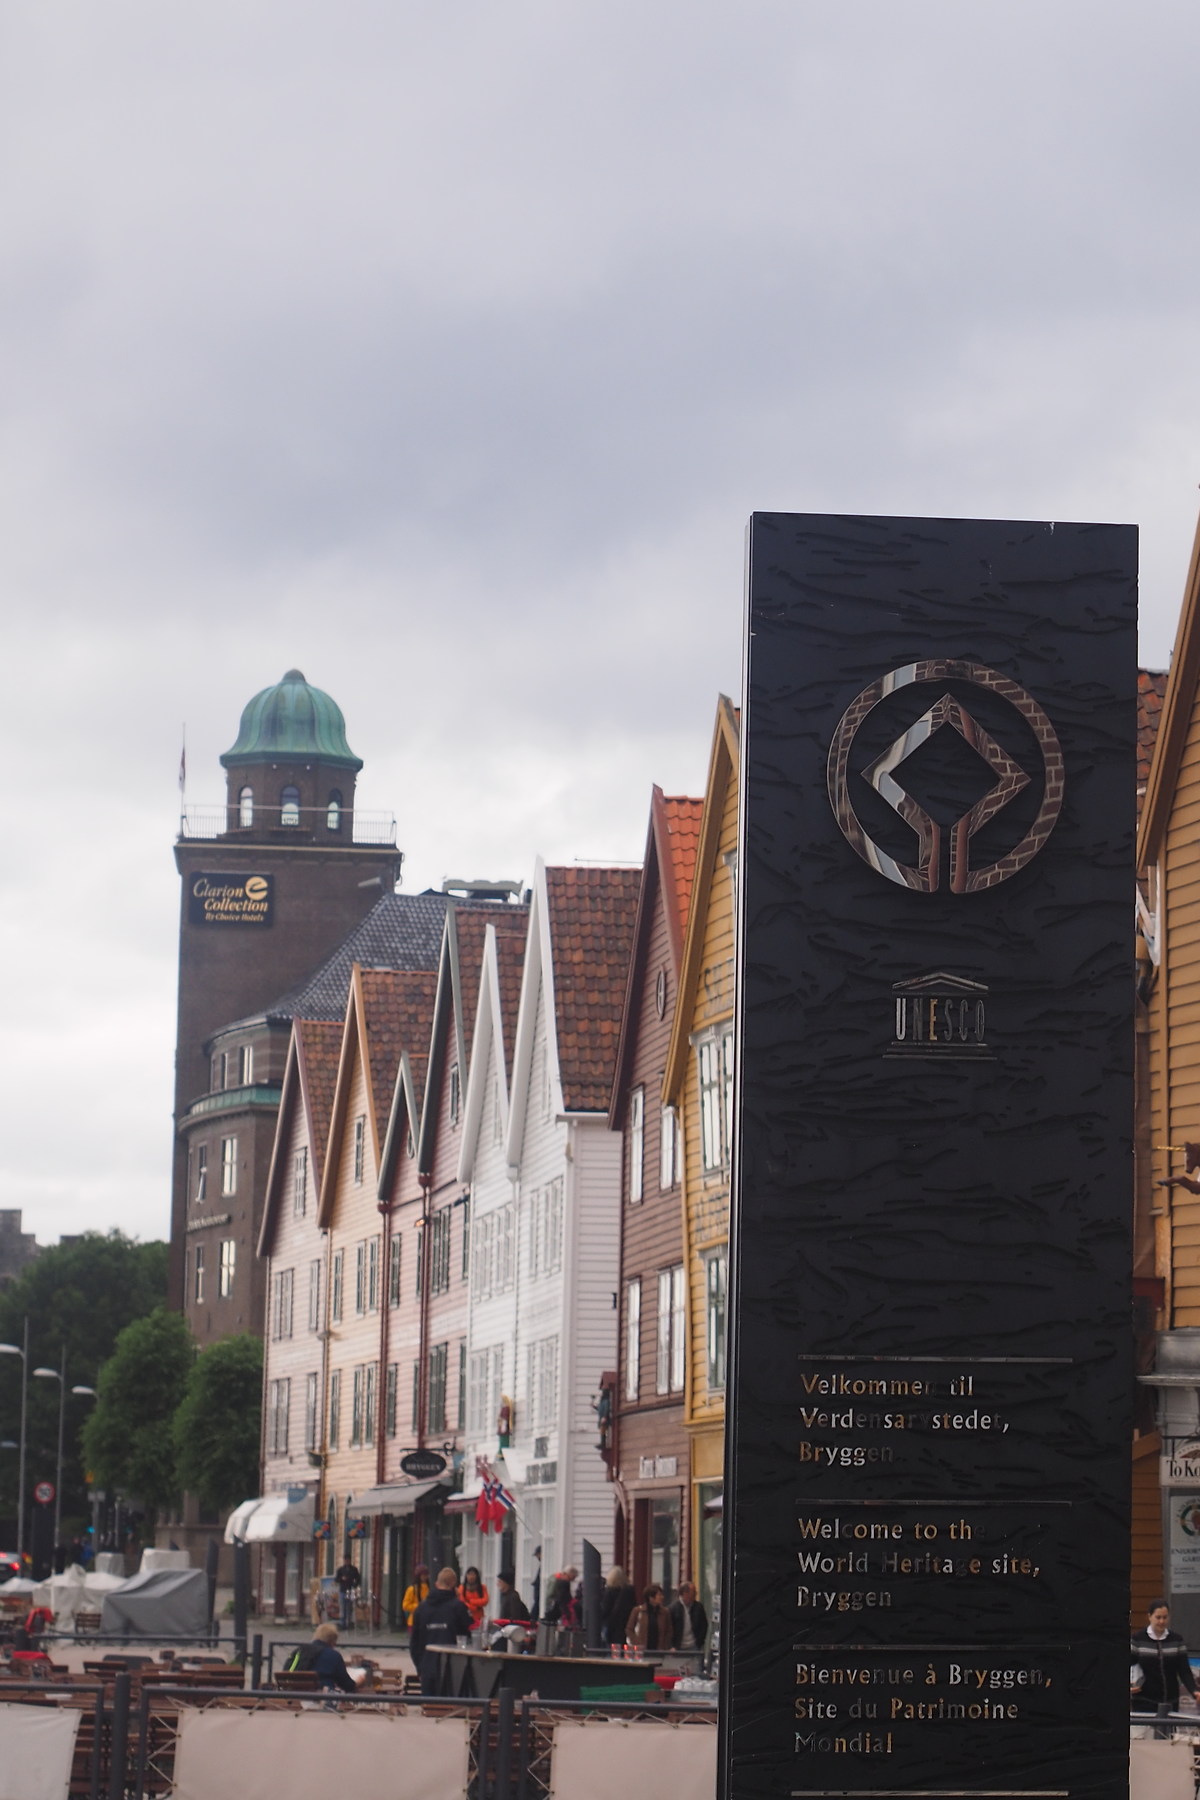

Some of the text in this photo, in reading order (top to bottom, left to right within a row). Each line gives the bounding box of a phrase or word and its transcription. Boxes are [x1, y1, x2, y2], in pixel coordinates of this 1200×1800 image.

[193, 878, 244, 898] Clarion
[204, 897, 268, 912] Collection
[215, 912, 240, 921] Choice
[241, 913, 264, 922] Hotels
[896, 998, 985, 1041] UNESCO
[800, 1373, 975, 1397] Velkommen til
[798, 1441, 894, 1467] Bryggen
[1166, 1460, 1183, 1478] To
[797, 1518, 986, 1541] Welcome to the
[797, 1551, 1041, 1578] World Heritage site,
[797, 1585, 893, 1612] Bryggen
[795, 1663, 1053, 1690] Bienvenue à Bryggen,
[794, 1697, 1019, 1720] Site du Patrimoine
[793, 1731, 894, 1754] Mondial
